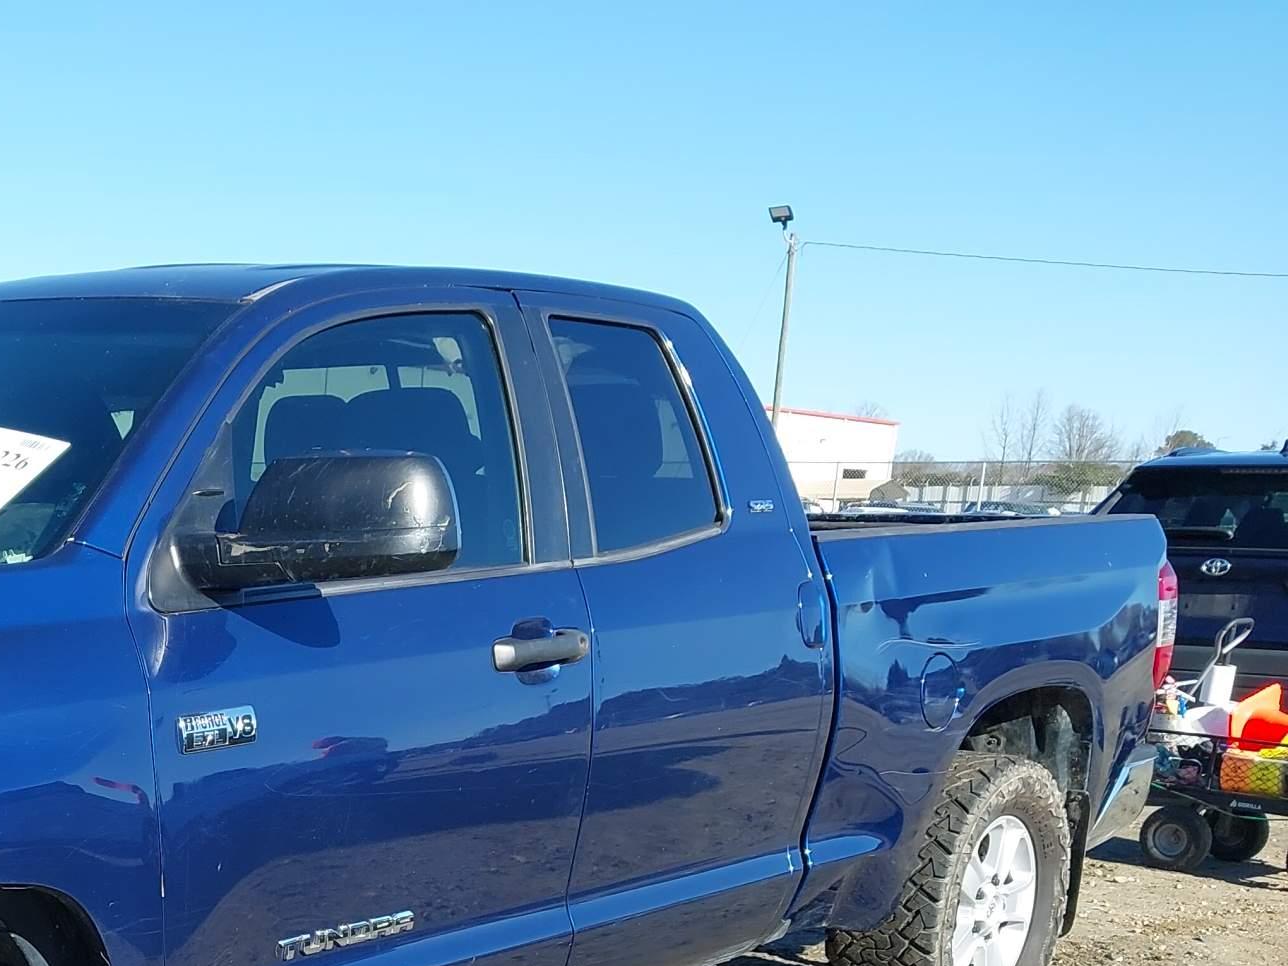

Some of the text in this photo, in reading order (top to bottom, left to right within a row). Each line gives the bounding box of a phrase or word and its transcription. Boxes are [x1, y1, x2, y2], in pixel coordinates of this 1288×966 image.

[228, 714, 254, 739] V8
[192, 729, 224, 748] 5.7L
[1237, 801, 1262, 810] GORILLA
[275, 910, 415, 962] TUNDRA
